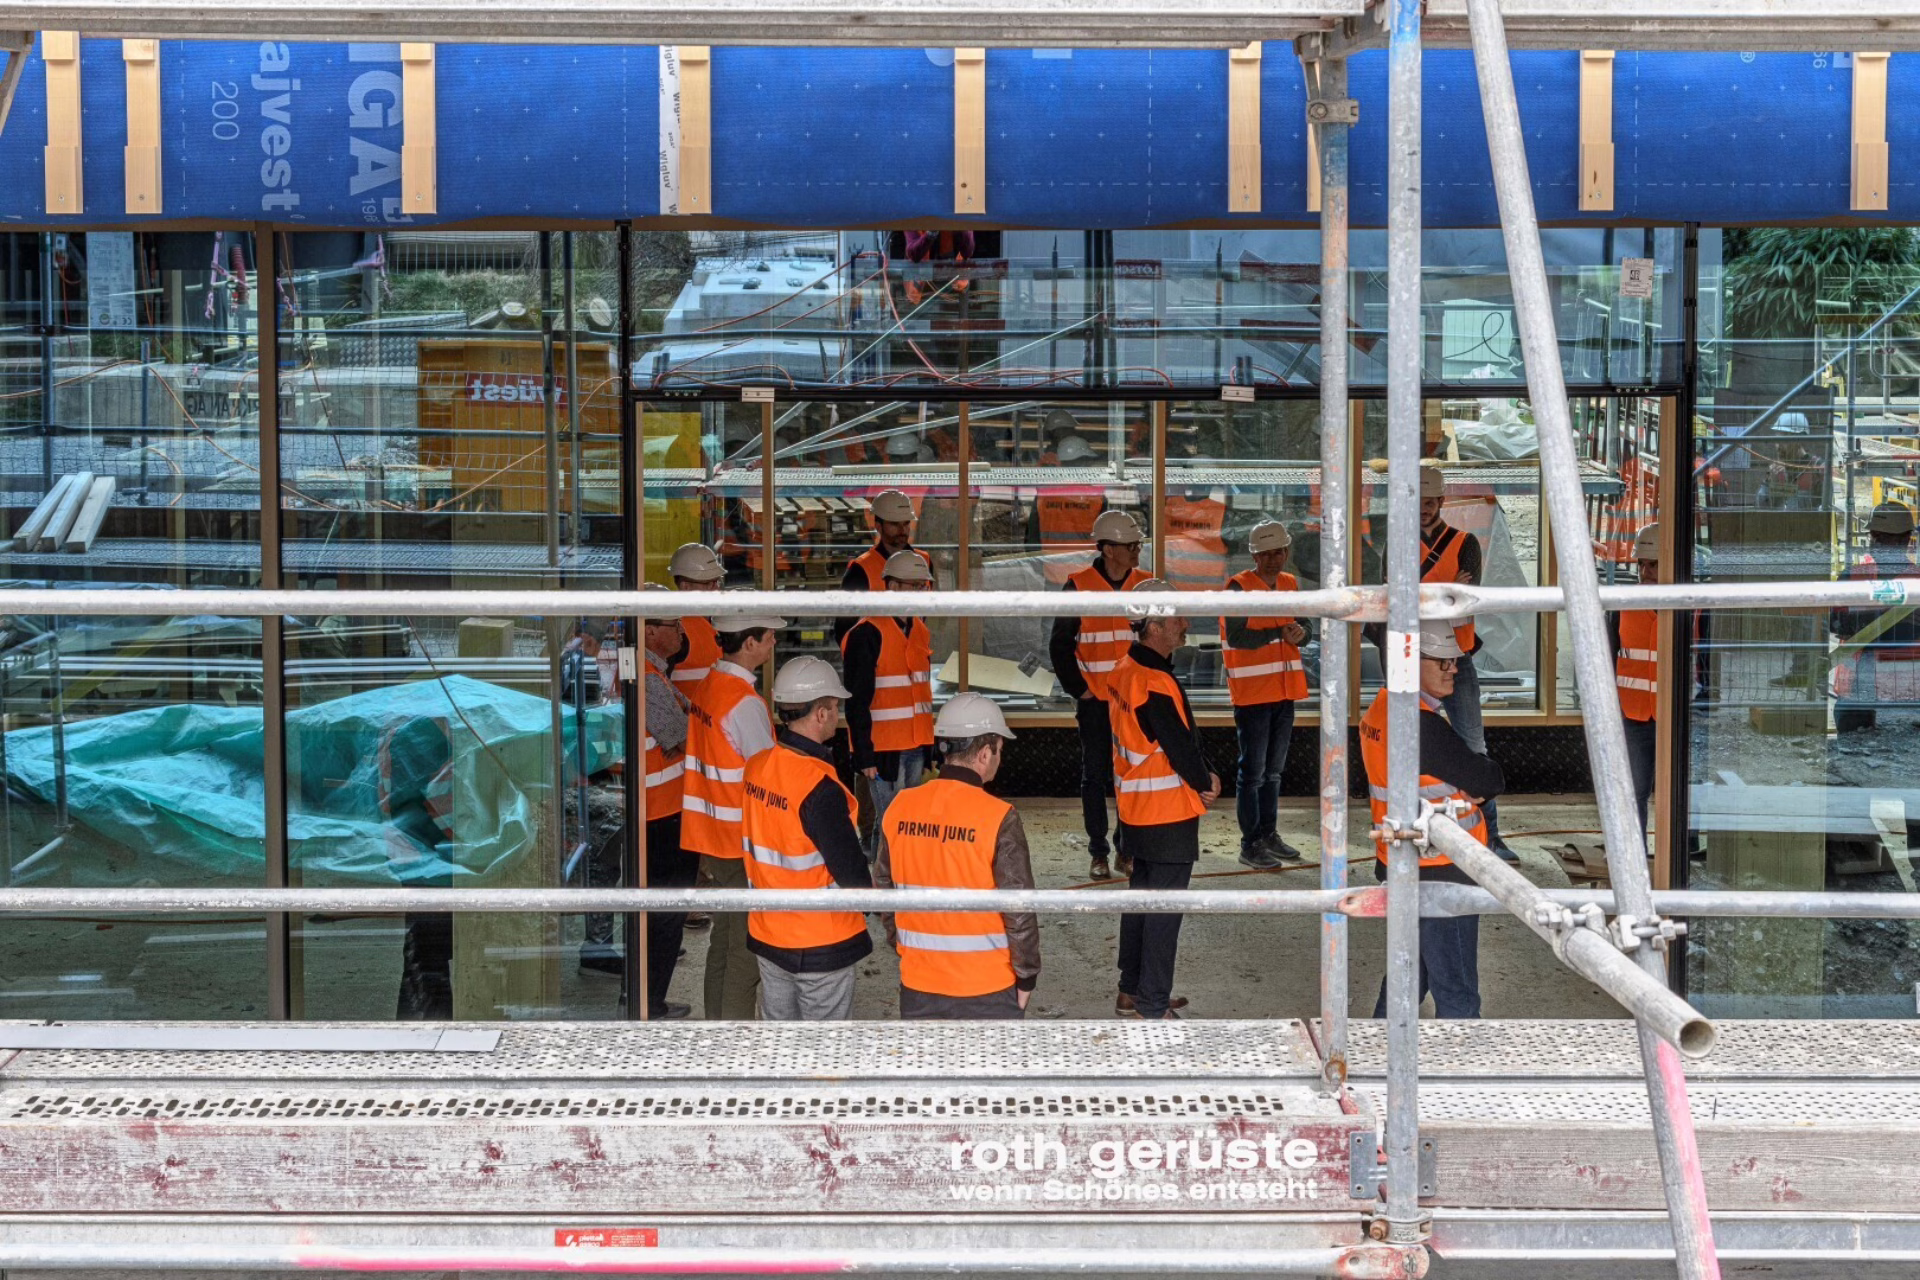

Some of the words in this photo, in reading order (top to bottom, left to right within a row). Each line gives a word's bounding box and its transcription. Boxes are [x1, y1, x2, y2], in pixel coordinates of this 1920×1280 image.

[211, 81, 240, 141] 200
[766, 791, 788, 811] JUNG
[898, 821, 940, 838] PIRMIN
[942, 825, 976, 844] JUNG
[951, 1132, 1067, 1171] roth
[1089, 1129, 1318, 1179] gerüste
[950, 1184, 1032, 1201] wenn
[1043, 1178, 1180, 1201] Schönes
[1189, 1178, 1318, 1200] entsteht
